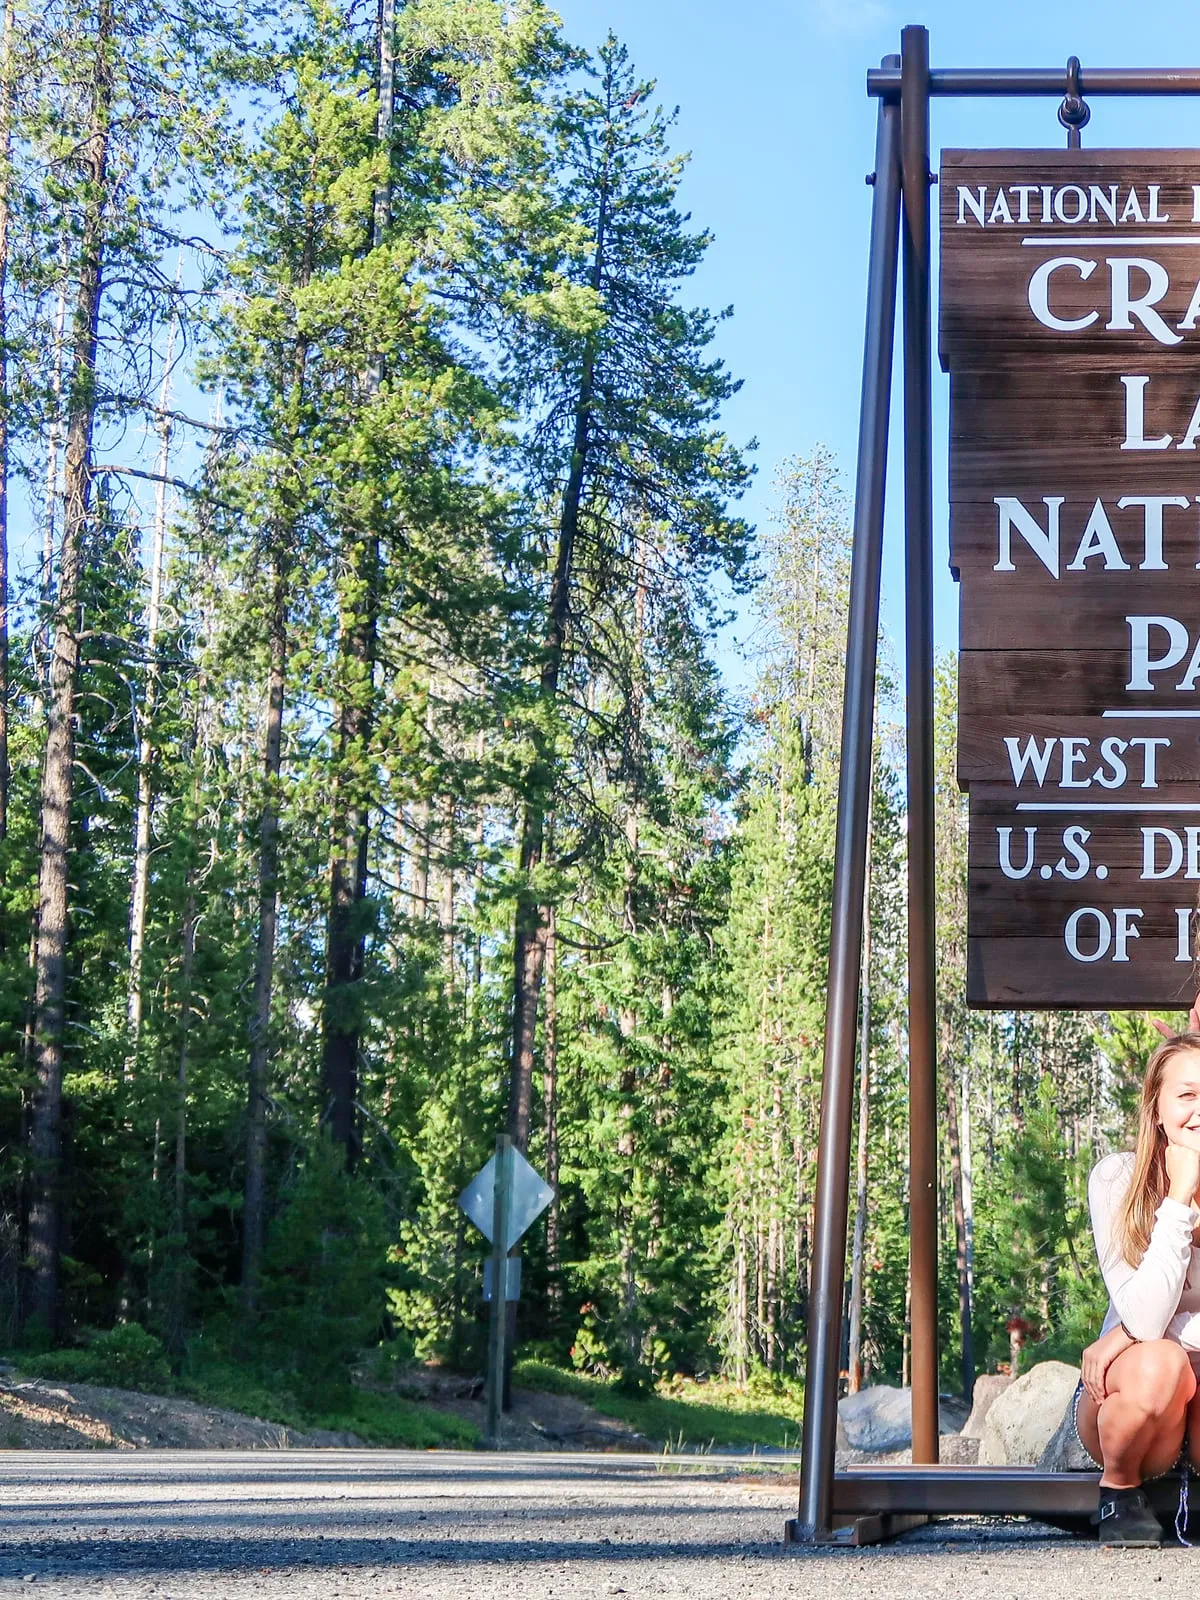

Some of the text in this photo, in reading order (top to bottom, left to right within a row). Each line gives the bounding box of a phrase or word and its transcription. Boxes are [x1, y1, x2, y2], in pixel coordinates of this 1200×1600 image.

[956, 185, 1170, 229] NATIONAL
[1003, 735, 1171, 789] WEST
[996, 825, 1108, 880] U.S.
[1064, 907, 1144, 962] OF
